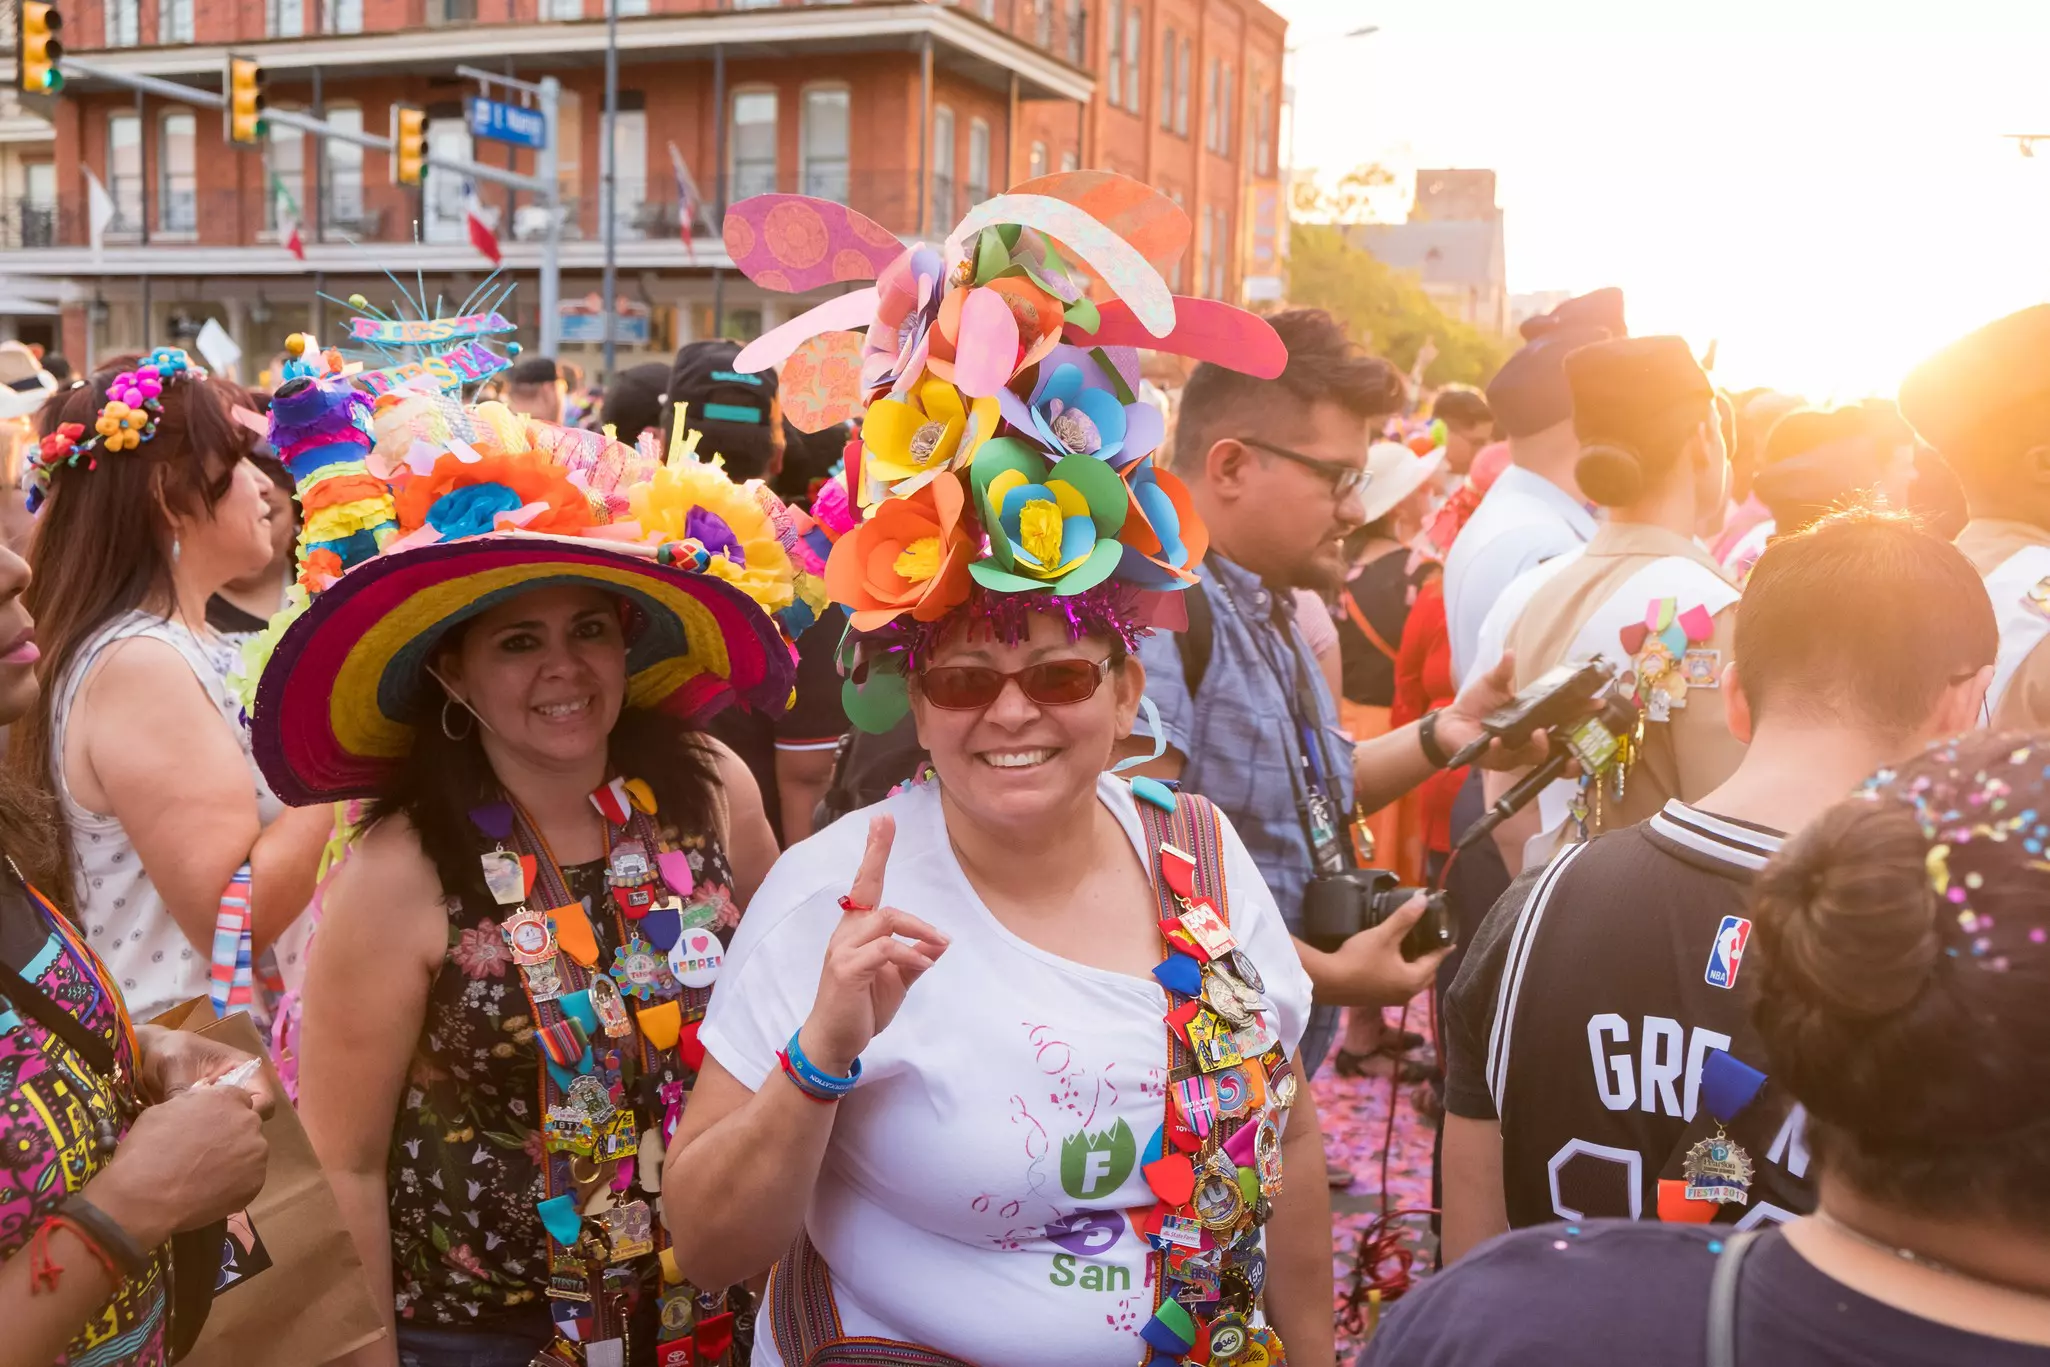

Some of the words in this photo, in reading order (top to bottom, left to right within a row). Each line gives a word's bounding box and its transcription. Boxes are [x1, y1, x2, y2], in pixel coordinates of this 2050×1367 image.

[350, 312, 512, 342] FIESTA
[681, 938, 688, 956] I
[1709, 969, 1727, 983] NBA
[1081, 1150, 1111, 1194] F
[1703, 1158, 1736, 1170] Pearson
[1687, 1188, 1720, 1198] FIESTA
[1722, 1188, 1746, 1202] 2017
[1049, 1253, 1132, 1292] San
[551, 1276, 586, 1293] FIESTA
[1222, 1334, 1237, 1347] 365
